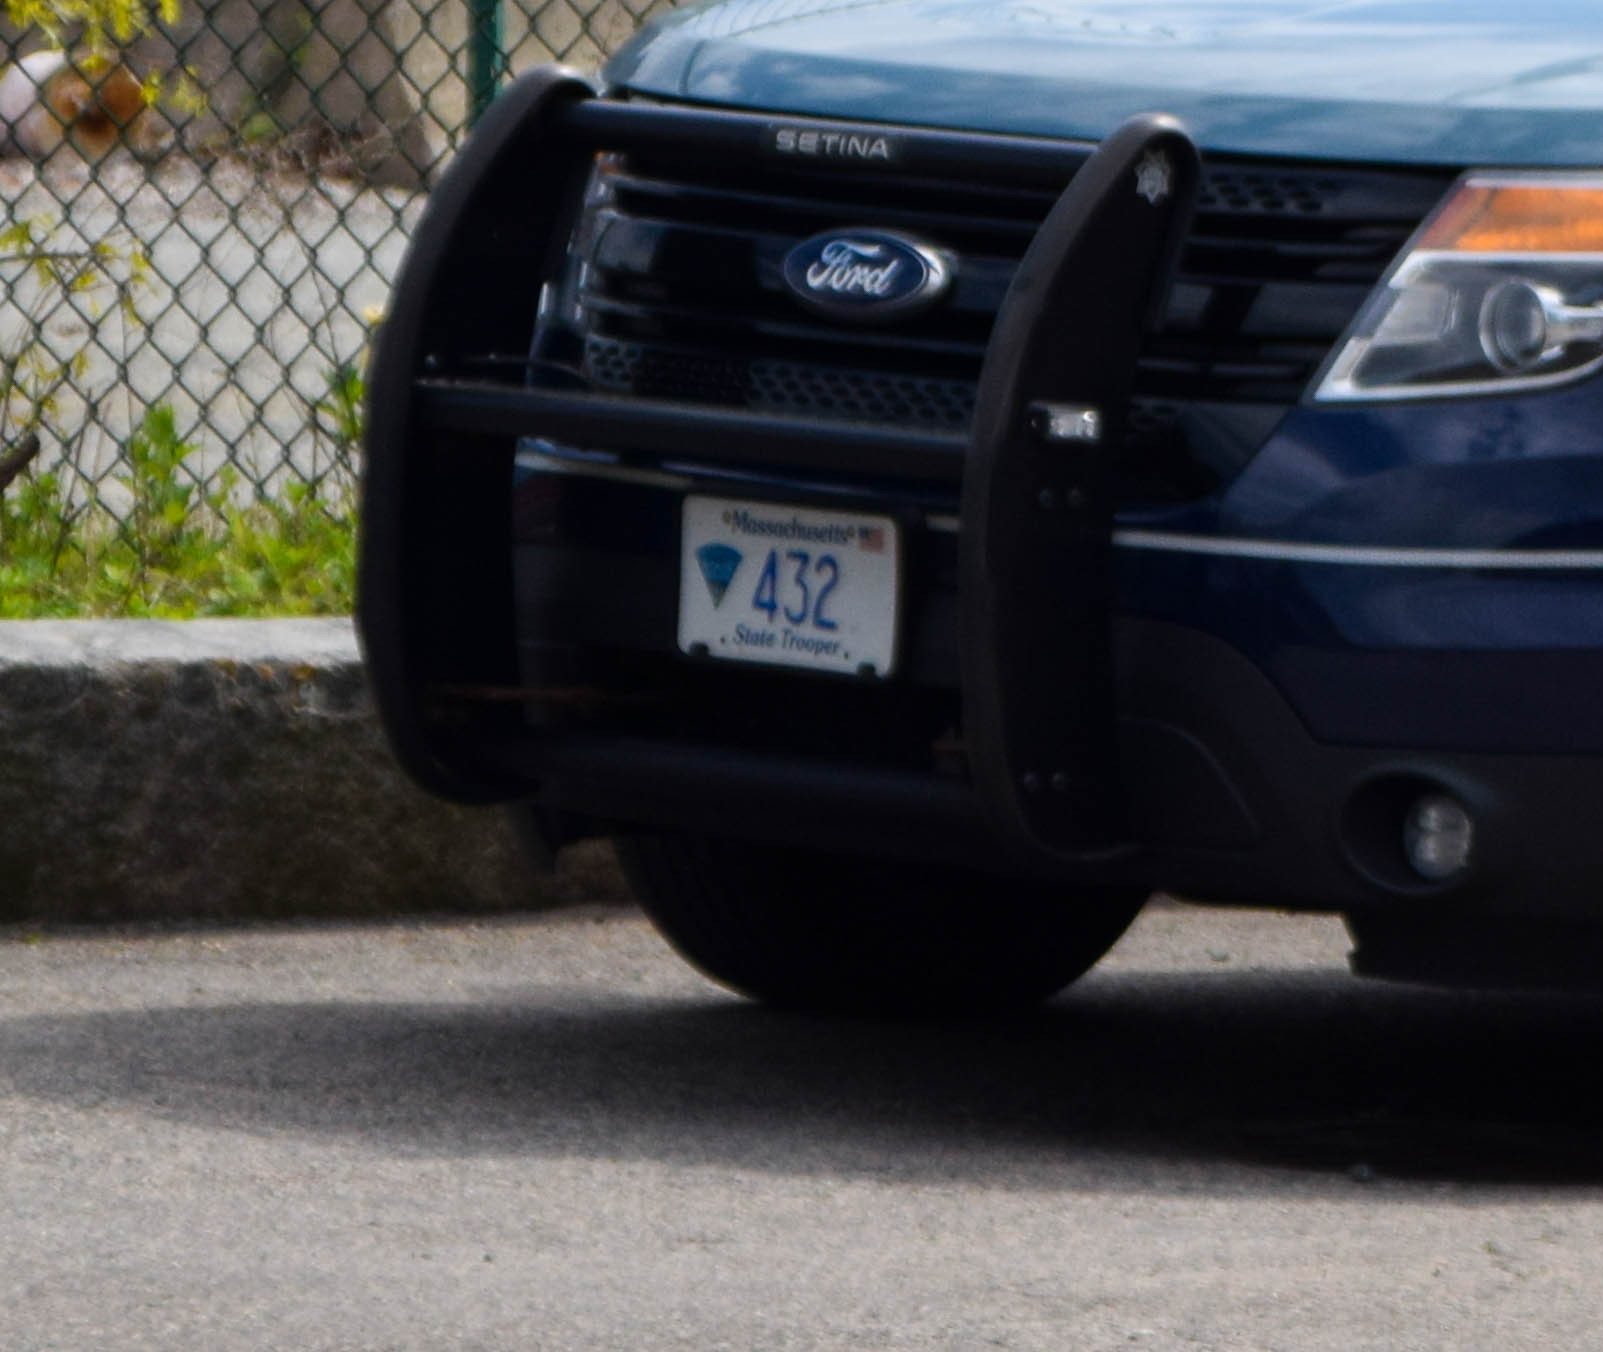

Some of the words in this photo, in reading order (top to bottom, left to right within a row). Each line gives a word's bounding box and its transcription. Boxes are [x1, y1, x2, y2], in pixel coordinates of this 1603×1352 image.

[775, 128, 892, 161] SETINA
[805, 239, 894, 298] Ford
[731, 509, 848, 544] Massachusetts
[751, 548, 840, 631] 432
[734, 623, 776, 651] State
[780, 626, 842, 658] Trooper
